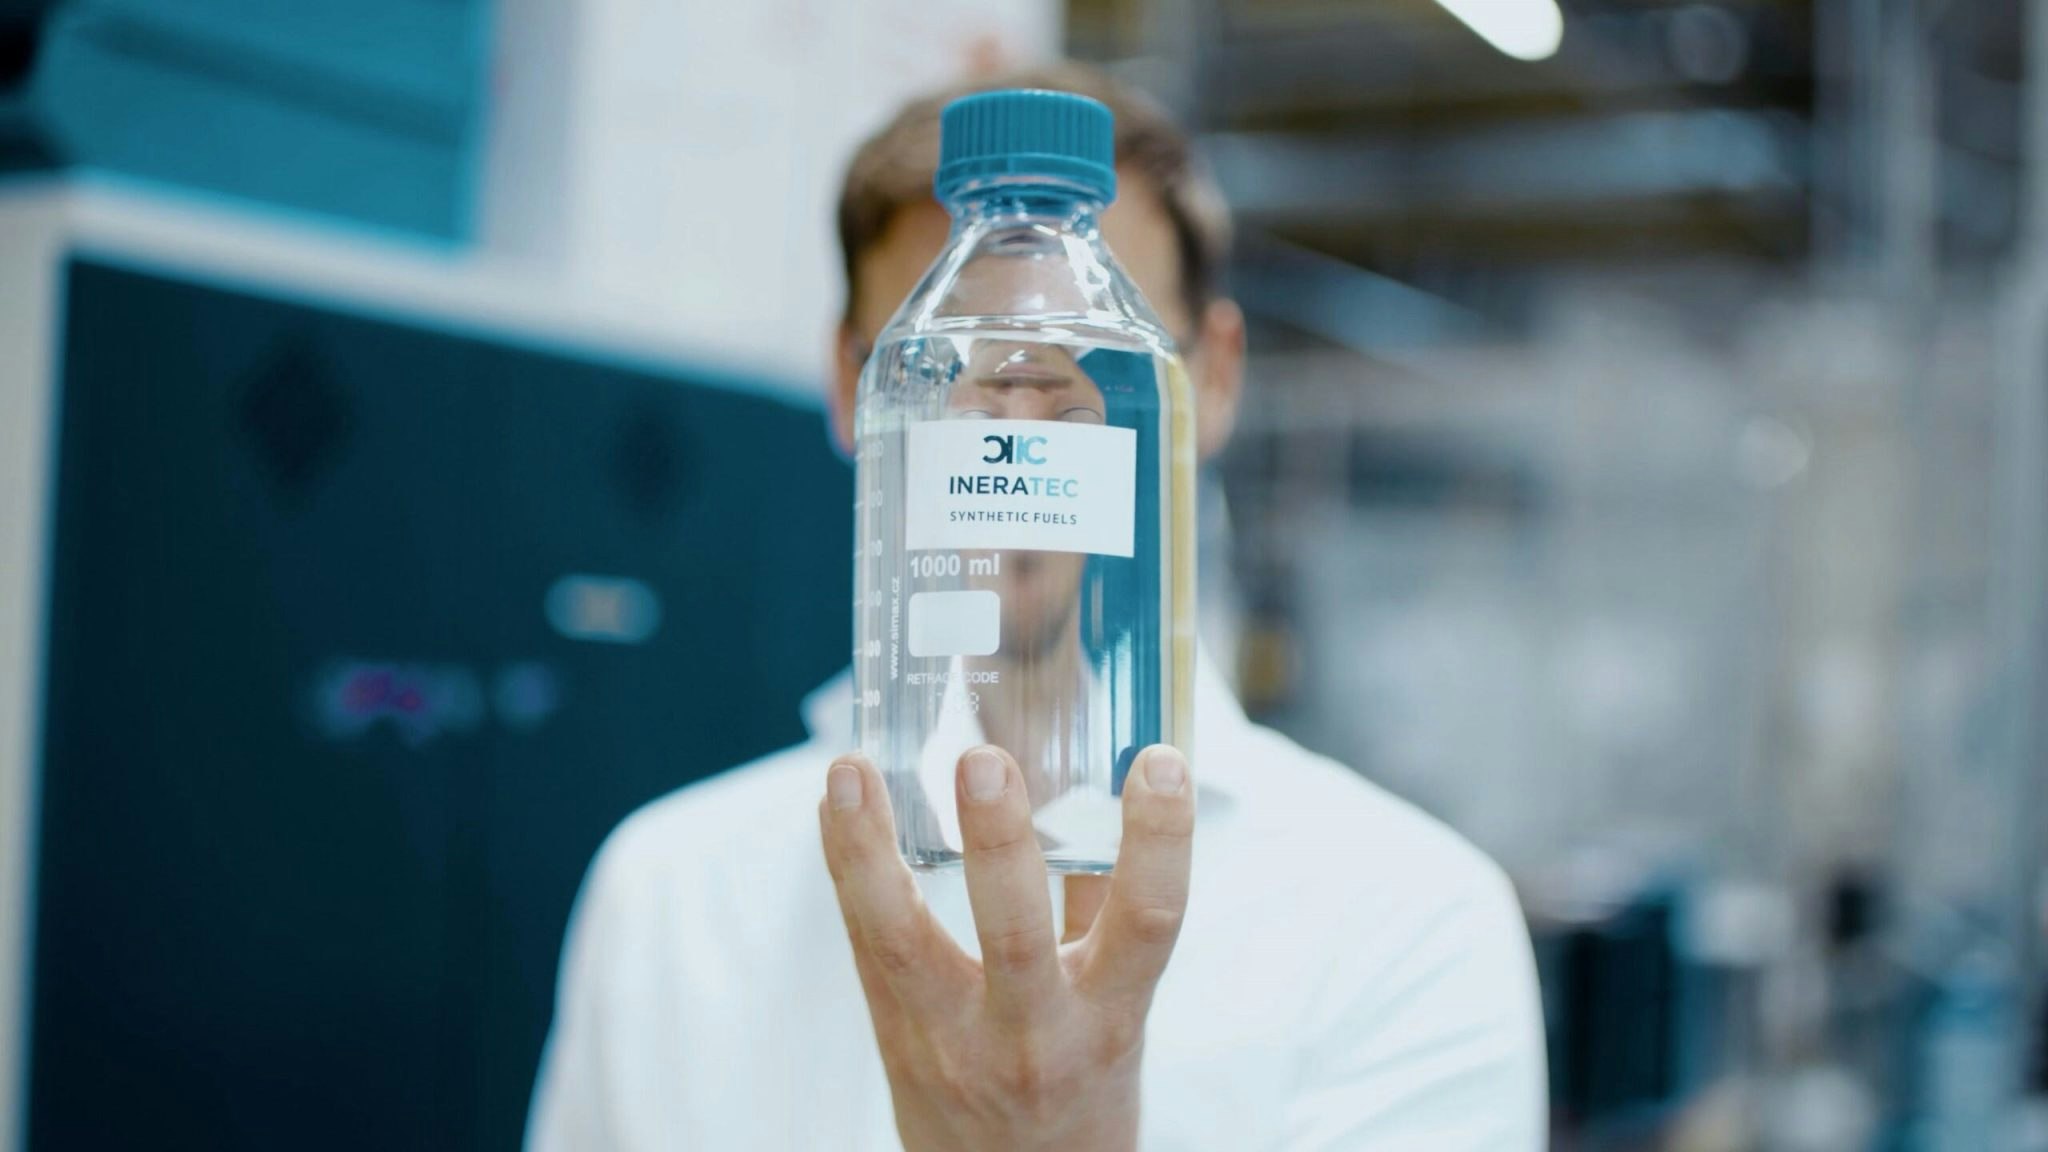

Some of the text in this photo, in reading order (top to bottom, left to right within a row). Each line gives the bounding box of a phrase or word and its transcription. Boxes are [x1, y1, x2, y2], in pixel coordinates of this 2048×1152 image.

[949, 475, 1079, 498] INERATEC
[950, 510, 1077, 525] SYNTHETIC FUELS
[910, 553, 1000, 578] 1000 ml
